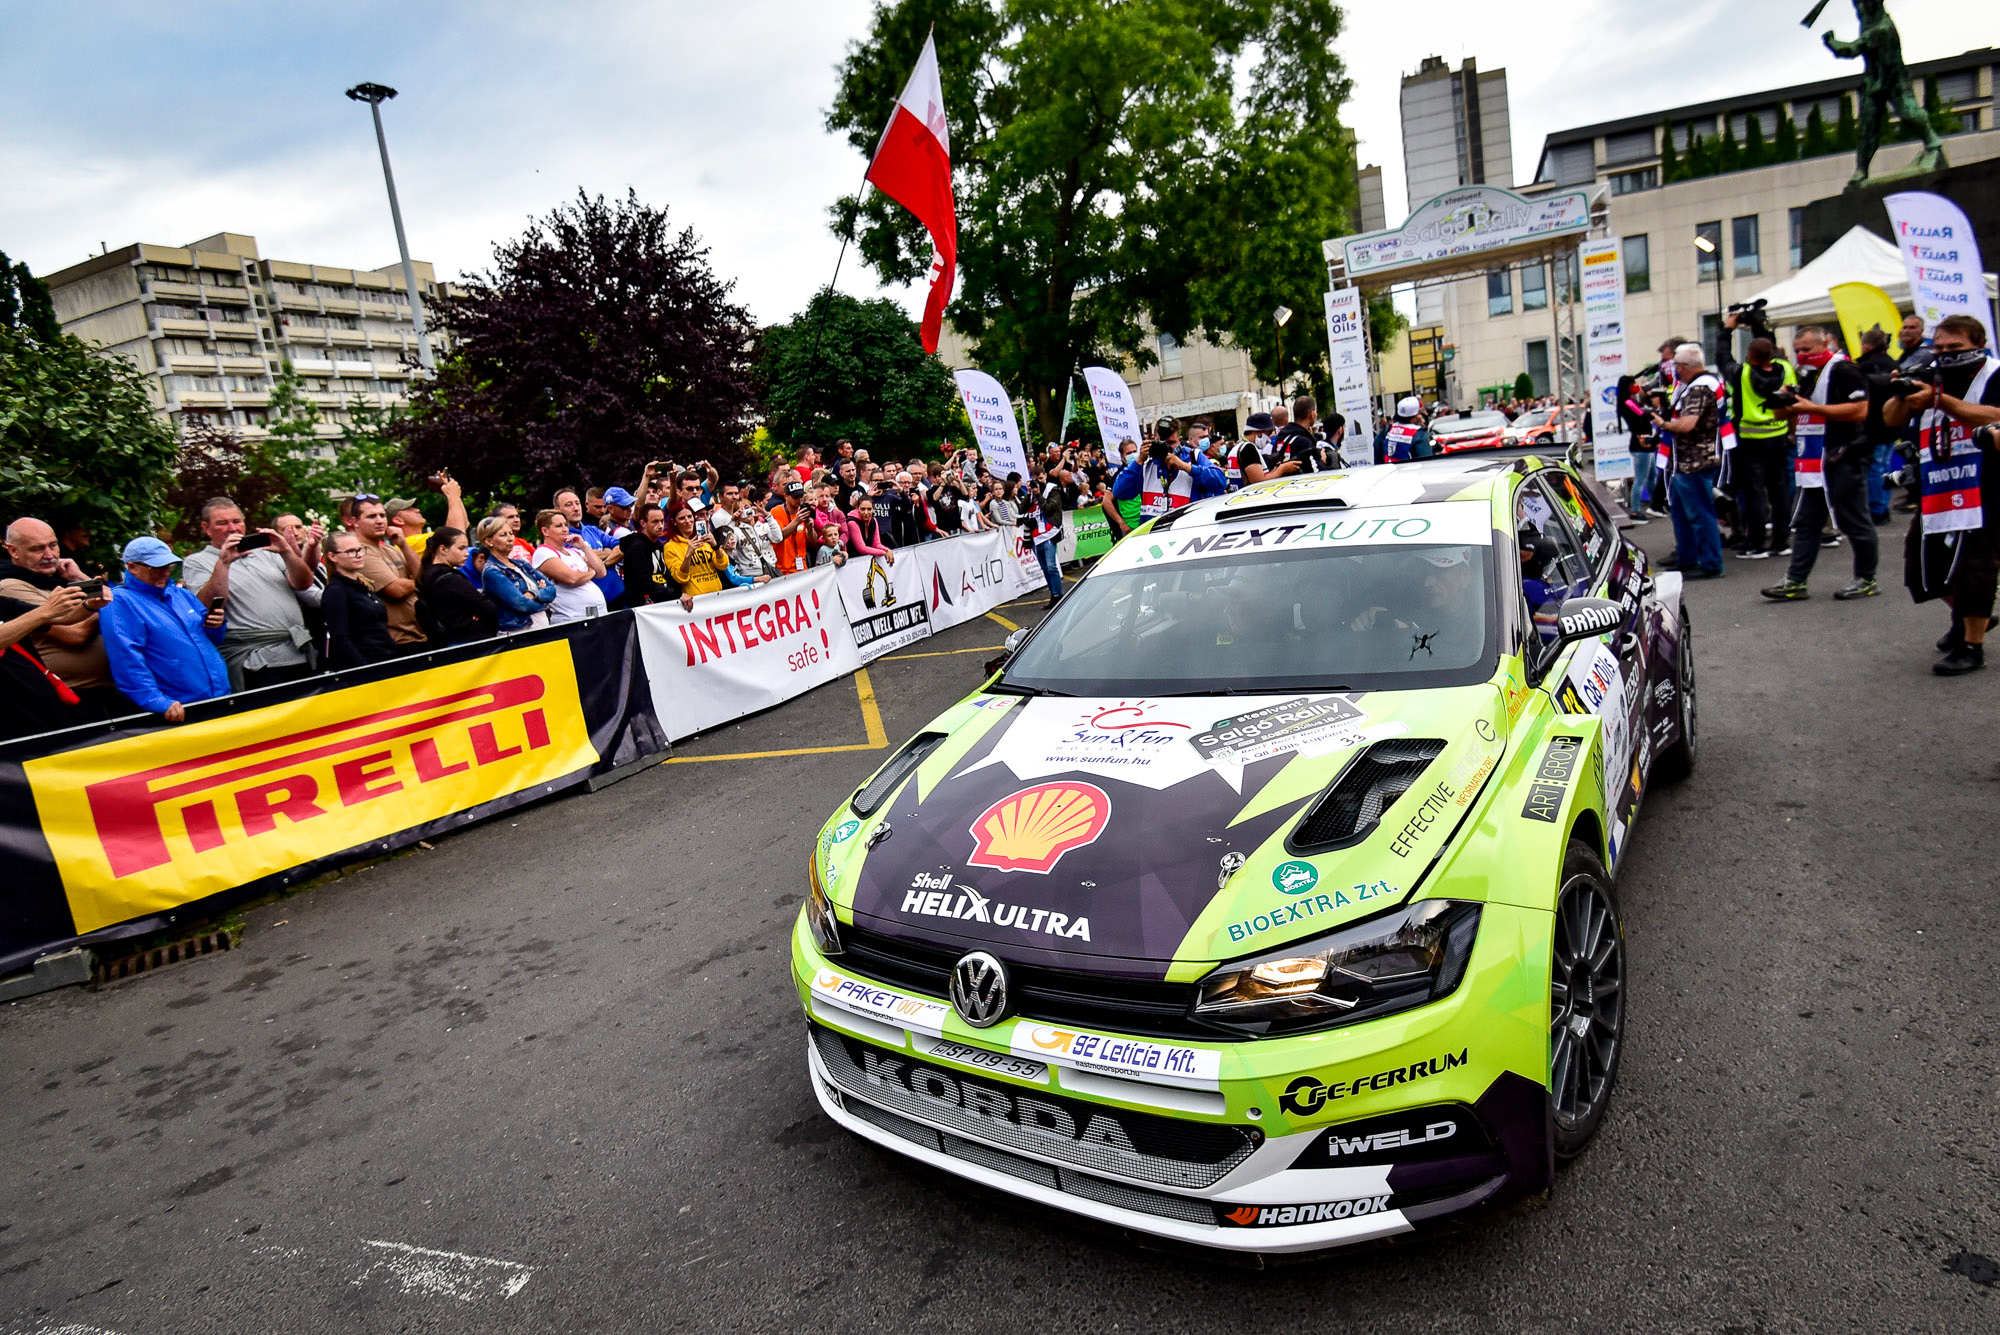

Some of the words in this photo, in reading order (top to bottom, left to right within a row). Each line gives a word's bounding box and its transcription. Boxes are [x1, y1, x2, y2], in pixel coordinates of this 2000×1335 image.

[1473, 203, 1533, 236] Rally
[1332, 313, 1348, 325] Q8
[1332, 322, 1357, 334] Oils
[871, 615, 893, 637] WELL
[1561, 606, 1621, 635] BRAUN
[1198, 719, 1273, 747] Salgó
[1273, 702, 1339, 725] Rally
[1045, 755, 1152, 766] www.sunfun.hu
[1542, 735, 1579, 780] GROUP
[85, 674, 546, 879] PIRELLI
[1389, 781, 1455, 858] EFFECTIVE
[911, 871, 954, 891] Shell
[1283, 876, 1317, 893] BIOEXTRA
[900, 884, 992, 924] HELIX
[993, 903, 1091, 943] ULTRA
[1227, 892, 1351, 943] BIOEXTRA
[1353, 879, 1400, 901] Zrt.
[946, 1045, 971, 1061] SP
[974, 1050, 1040, 1077] 09-55
[1072, 1034, 1100, 1058] 92
[1163, 1048, 1196, 1074] Kft.
[1075, 1060, 1140, 1077] eastmotorsport.hu
[863, 1050, 1142, 1160] KORDA
